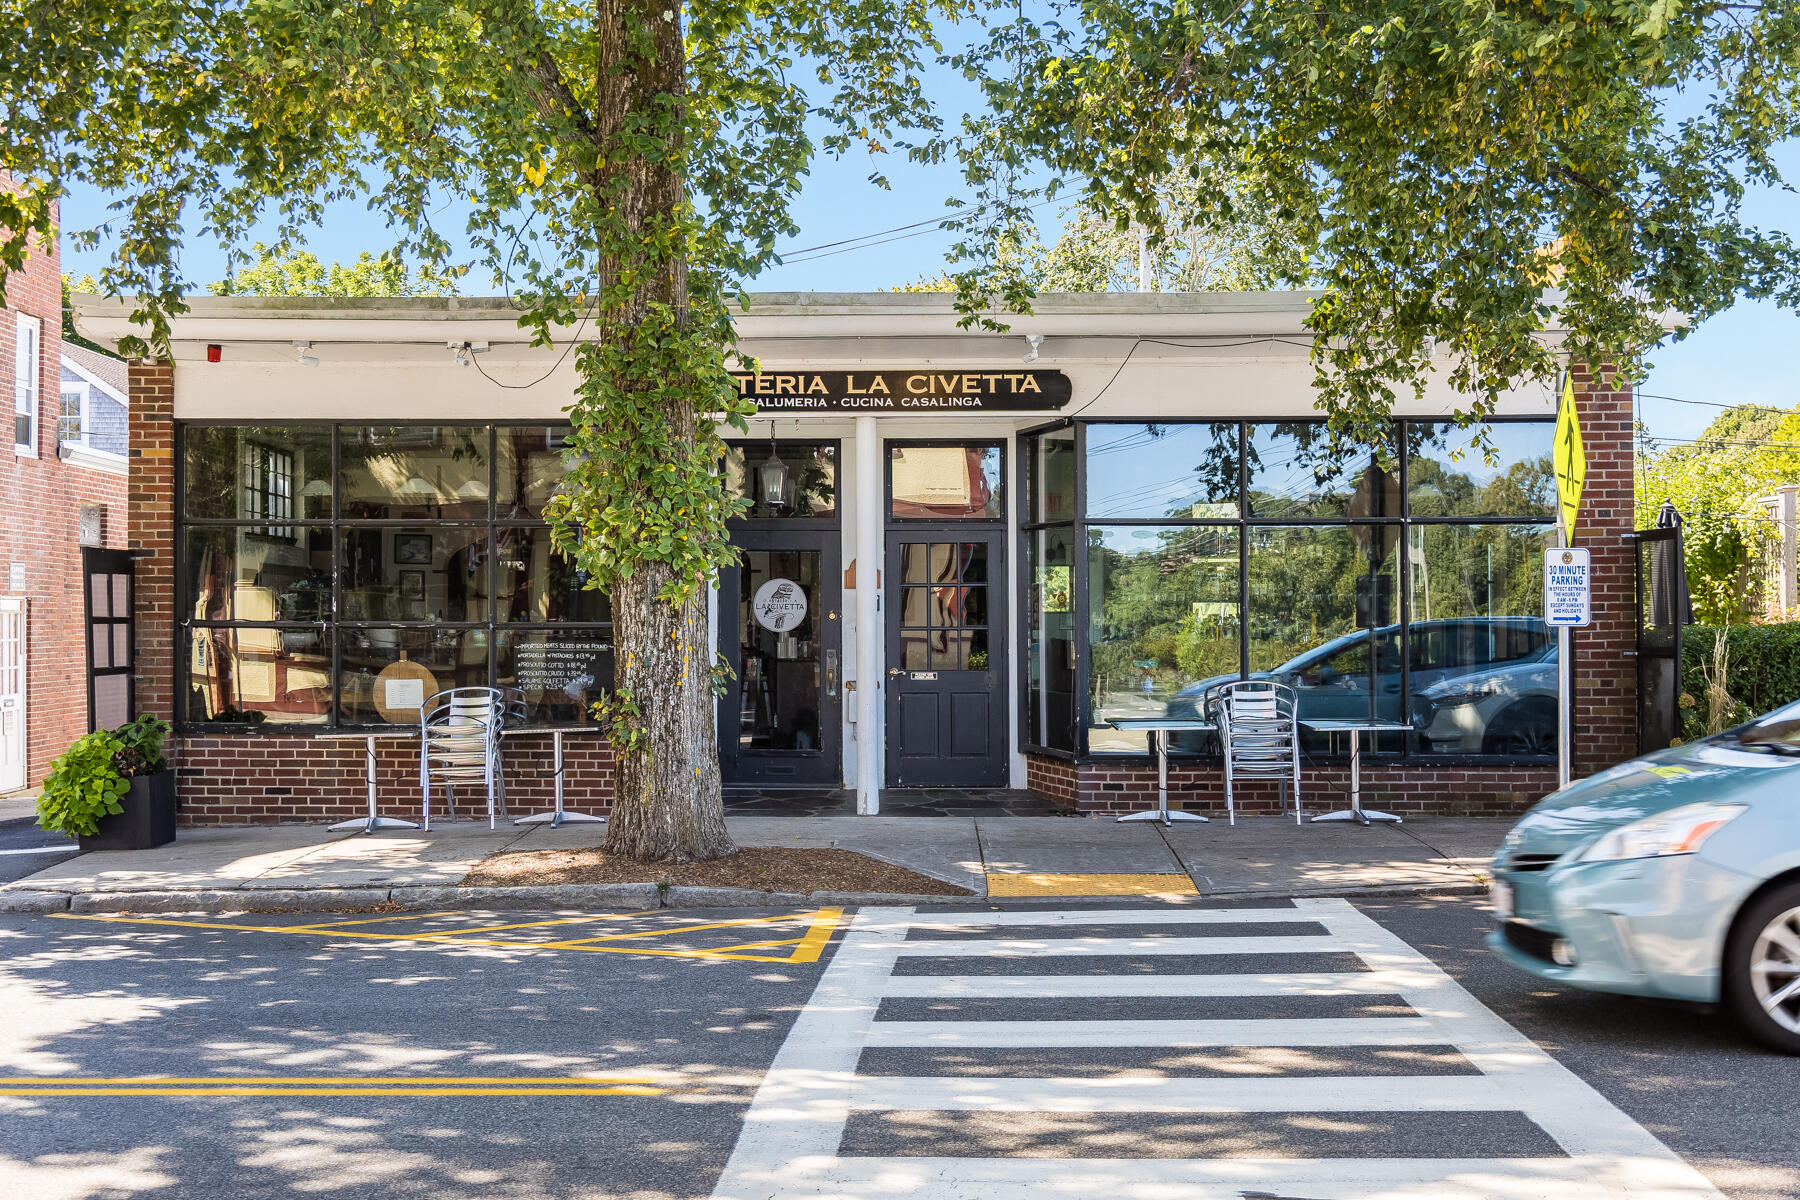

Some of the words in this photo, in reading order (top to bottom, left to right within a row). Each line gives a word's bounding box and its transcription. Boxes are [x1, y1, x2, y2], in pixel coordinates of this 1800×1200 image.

[735, 375, 829, 394] TERIA
[846, 375, 891, 394] LA
[905, 374, 1042, 394] CIVETTA
[840, 398, 894, 407] CUCINA
[901, 397, 982, 407] CASALINGA
[1549, 565, 1557, 575] 30
[1558, 565, 1586, 575] MINUTE
[1551, 575, 1583, 585] PARKING
